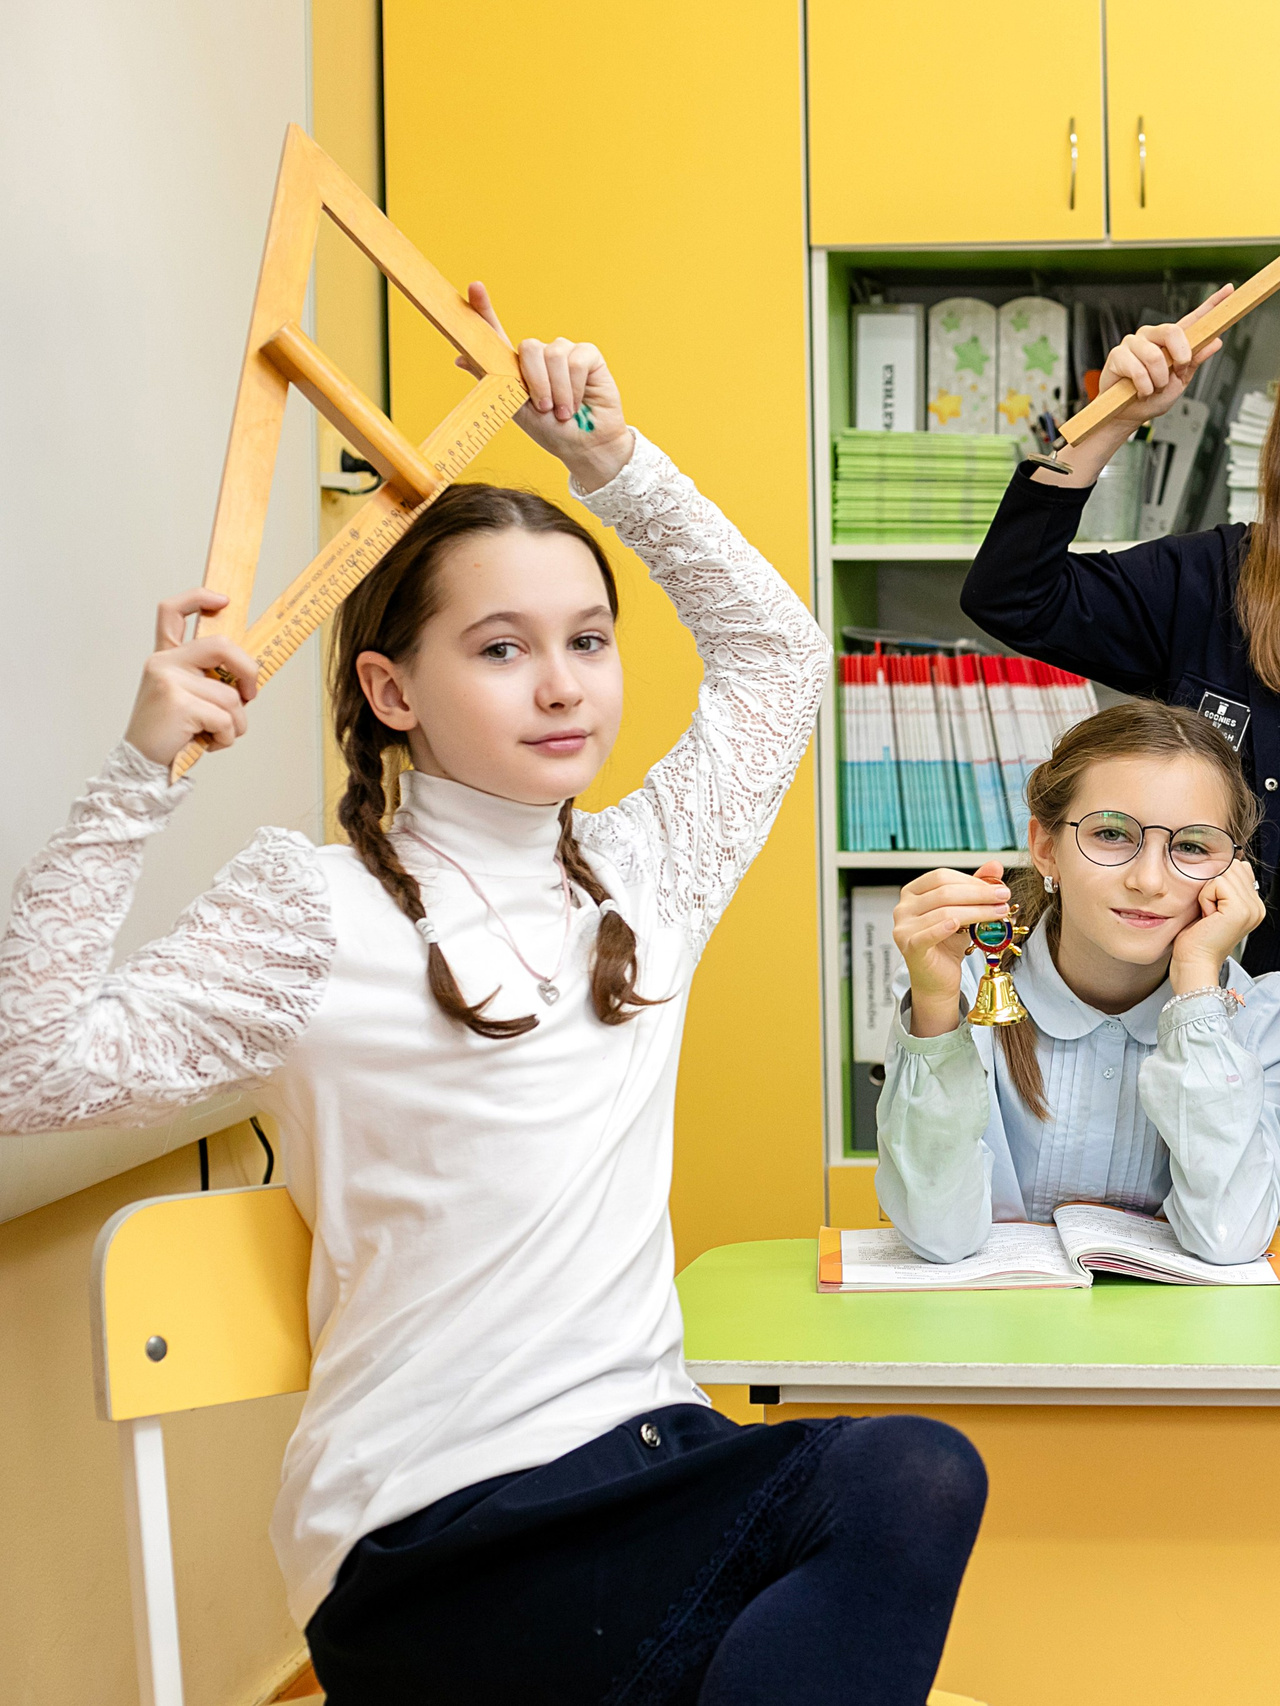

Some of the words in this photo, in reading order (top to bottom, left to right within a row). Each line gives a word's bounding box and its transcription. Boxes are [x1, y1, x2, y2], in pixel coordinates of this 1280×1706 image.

[506, 384, 514, 392] 2
[498, 394, 505, 402] 3
[434, 460, 445, 472] 10
[390, 508, 400, 518] 15
[374, 526, 382, 537] 17
[345, 554, 358, 568] 20
[337, 564, 348, 575] 21
[328, 574, 339, 586] 22
[319, 584, 329, 596] 23
[310, 594, 320, 605] 24
[1204, 710, 1237, 727] GOONIES
